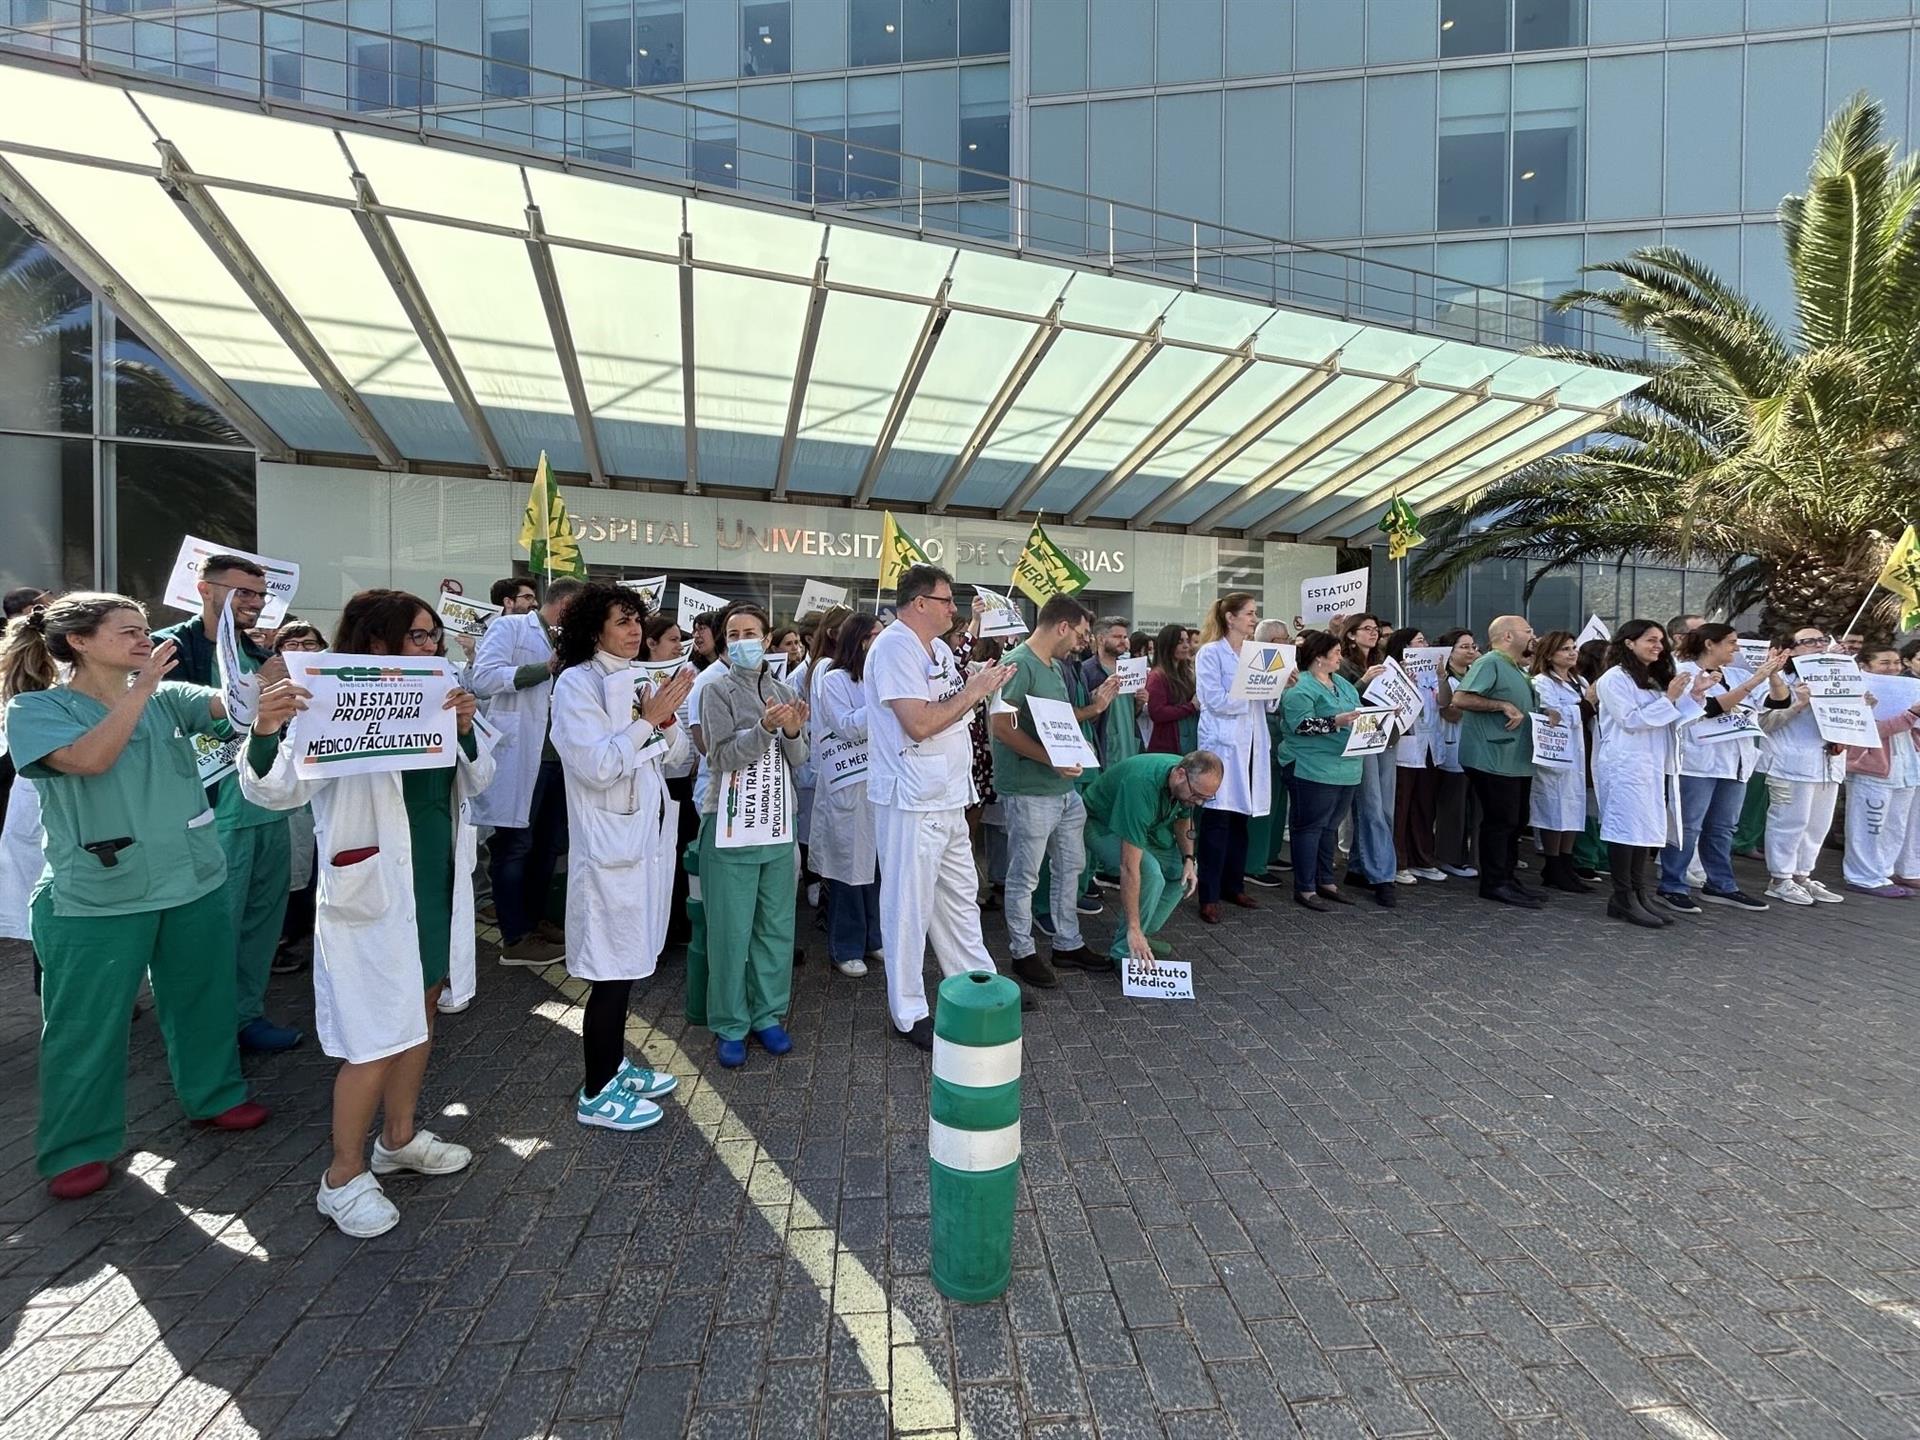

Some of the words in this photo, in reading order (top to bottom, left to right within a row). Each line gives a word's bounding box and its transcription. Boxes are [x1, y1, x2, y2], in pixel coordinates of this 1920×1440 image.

[567, 514, 699, 548] OSPITAL
[717, 518, 943, 562] UNIVERSITO
[957, 541, 989, 566] DE
[998, 537, 1124, 573] CRIAS
[1307, 581, 1362, 598] ESTATUTO
[1316, 598, 1355, 612] PROPIO
[1247, 674, 1278, 685] SEMCA
[337, 692, 356, 707] UN
[360, 692, 423, 706] ESTATUTO
[332, 709, 385, 721] PROPIO
[388, 707, 420, 719] PARA
[1829, 707, 1860, 716] ESTATUTO
[1829, 716, 1854, 725] MÉDICO
[366, 722, 381, 735] EL
[307, 733, 442, 756] MÉDICO/FACULTATIVO
[837, 741, 853, 752] POR
[835, 760, 848, 771] DE
[746, 759, 758, 791] TRAM
[763, 773, 770, 782] 17
[774, 775, 781, 786] DE
[760, 783, 770, 824] GUARDIAS
[745, 794, 757, 828] NUEVA
[772, 786, 781, 837] DEVOLUCIÓN
[1128, 975, 1176, 988] Médico
